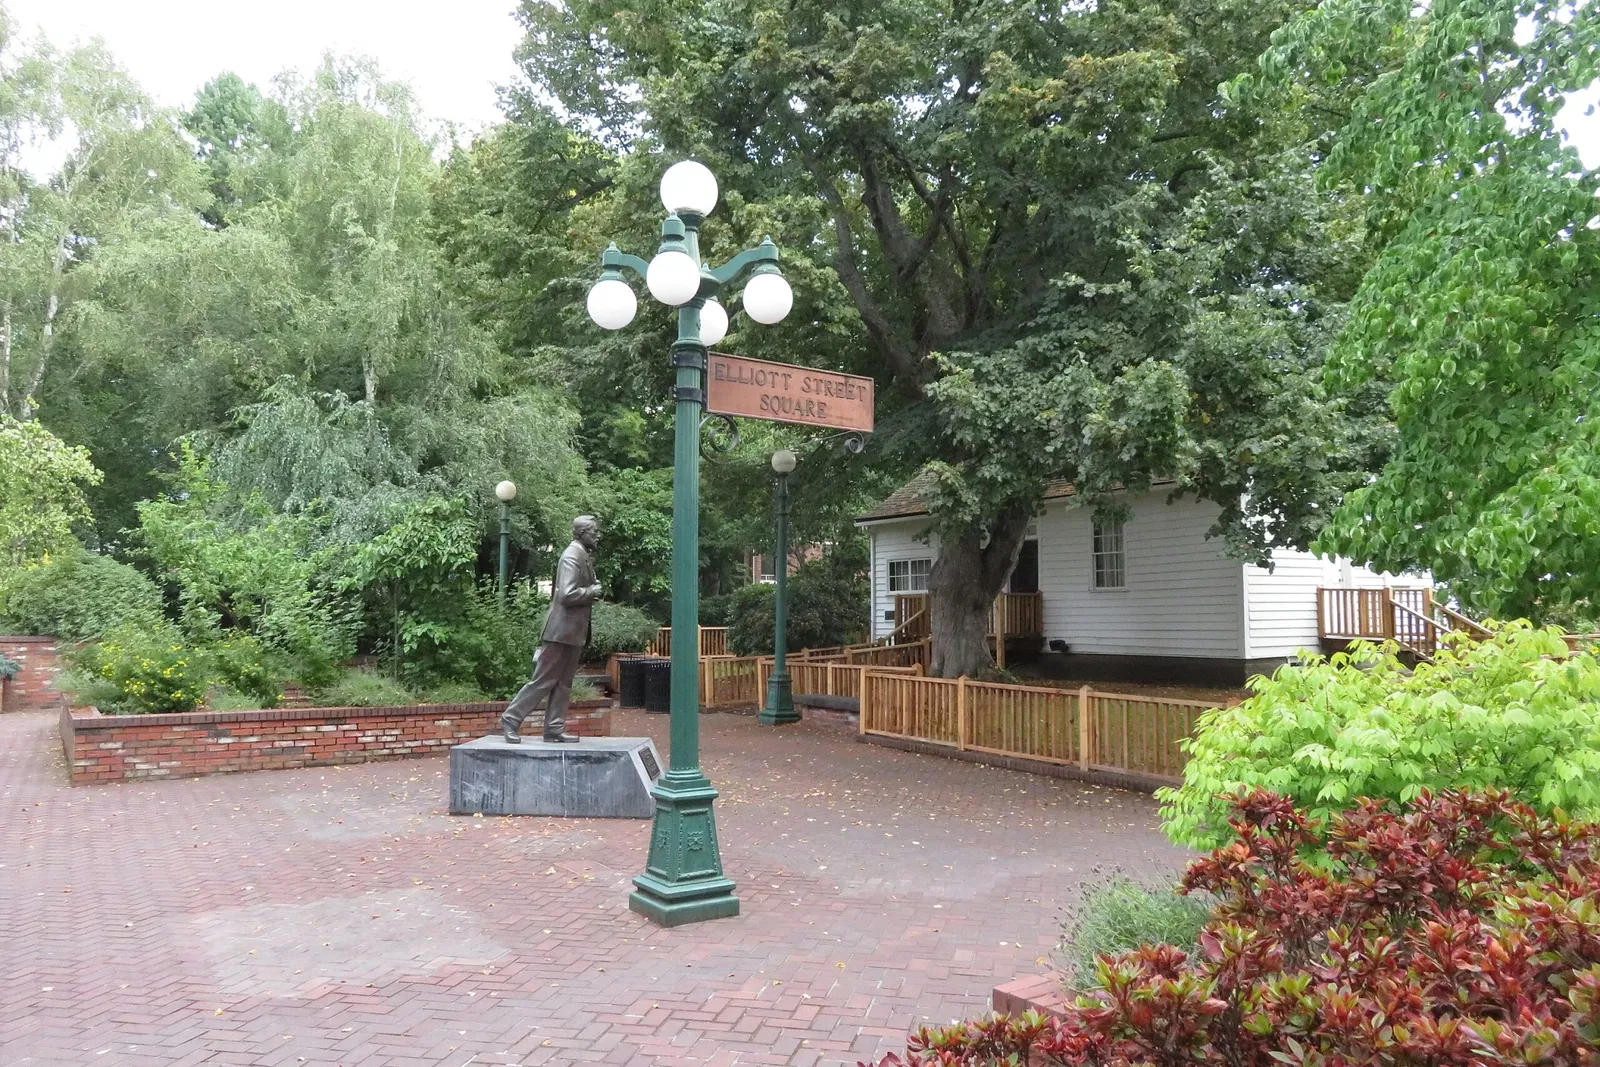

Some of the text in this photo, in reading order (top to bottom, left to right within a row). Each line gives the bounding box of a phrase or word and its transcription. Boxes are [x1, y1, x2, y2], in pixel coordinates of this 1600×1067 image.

[714, 362, 867, 402] ELLIOTT STREET
[760, 393, 827, 418] SQUARE
